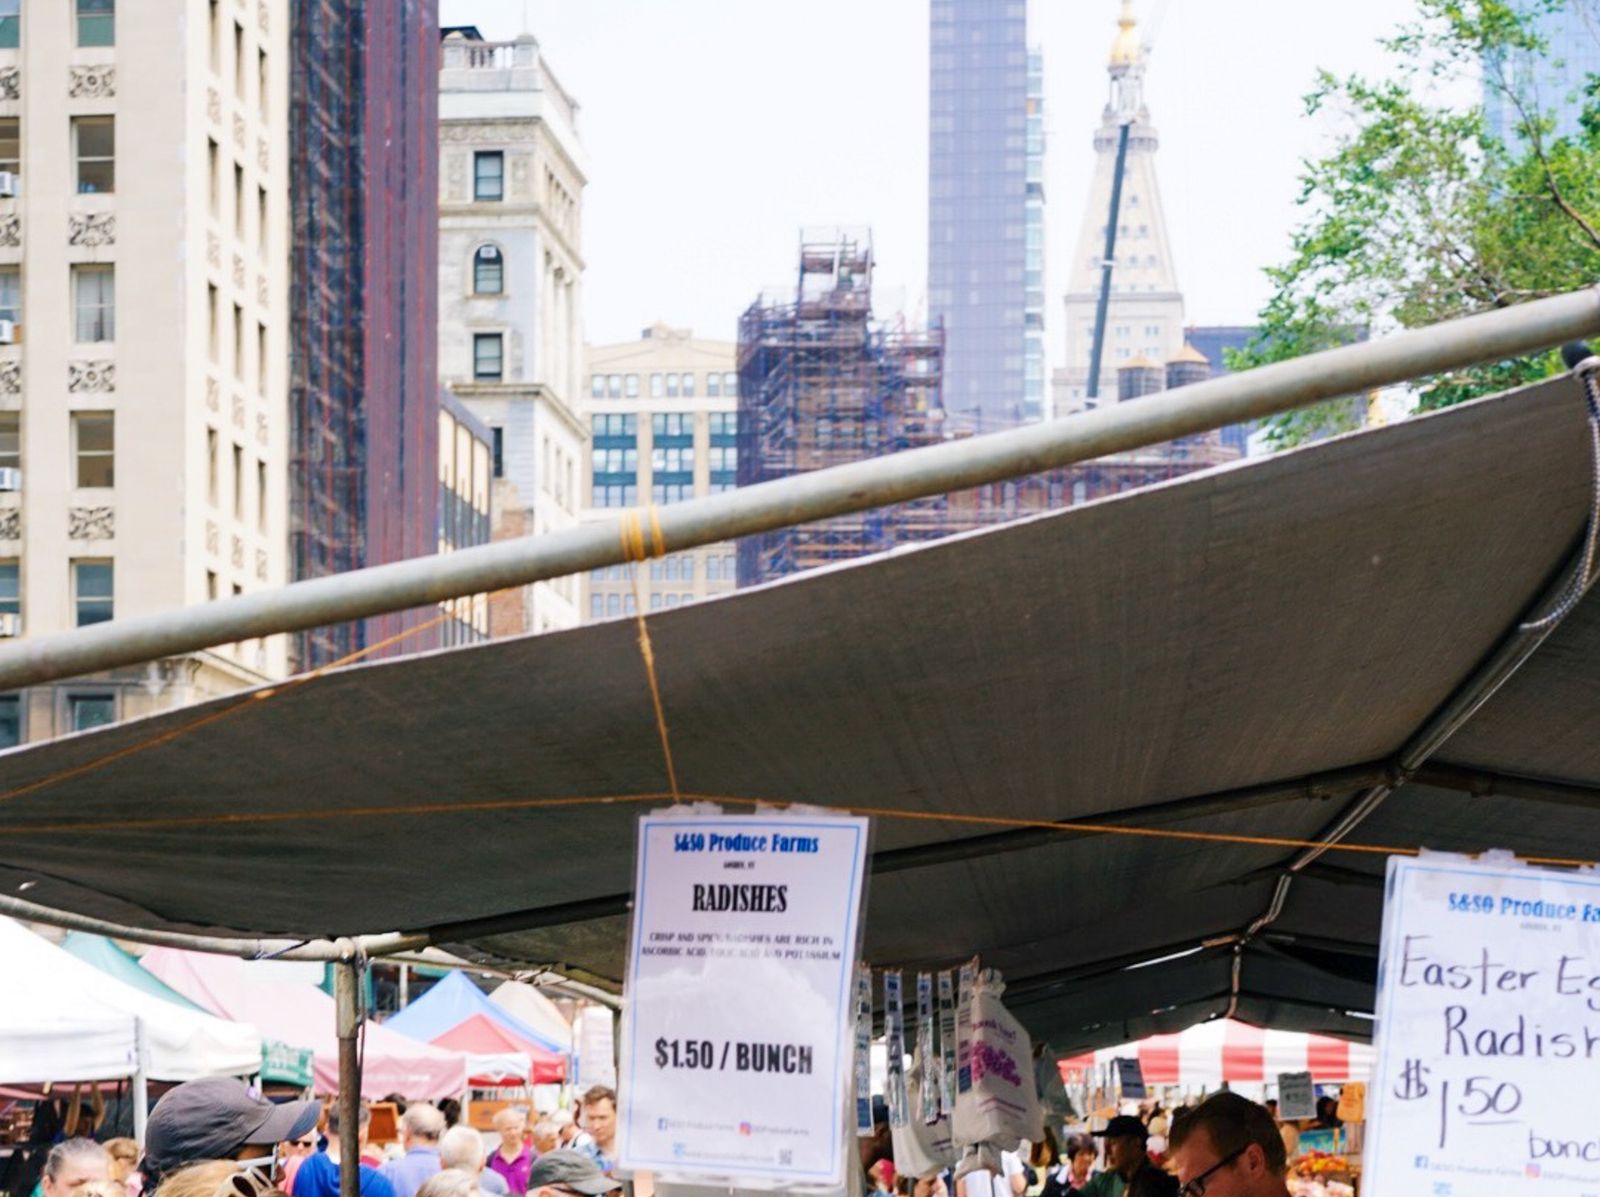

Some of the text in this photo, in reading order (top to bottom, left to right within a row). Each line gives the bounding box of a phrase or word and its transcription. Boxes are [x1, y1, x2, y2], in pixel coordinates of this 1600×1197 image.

[709, 833, 766, 852] Produce
[771, 833, 819, 853] Farms
[692, 884, 788, 912] RADISHES
[1500, 896, 1576, 920] Produce
[1400, 934, 1539, 995] Easter
[655, 1037, 713, 1070] $1.50
[736, 1043, 813, 1074] BUNCH
